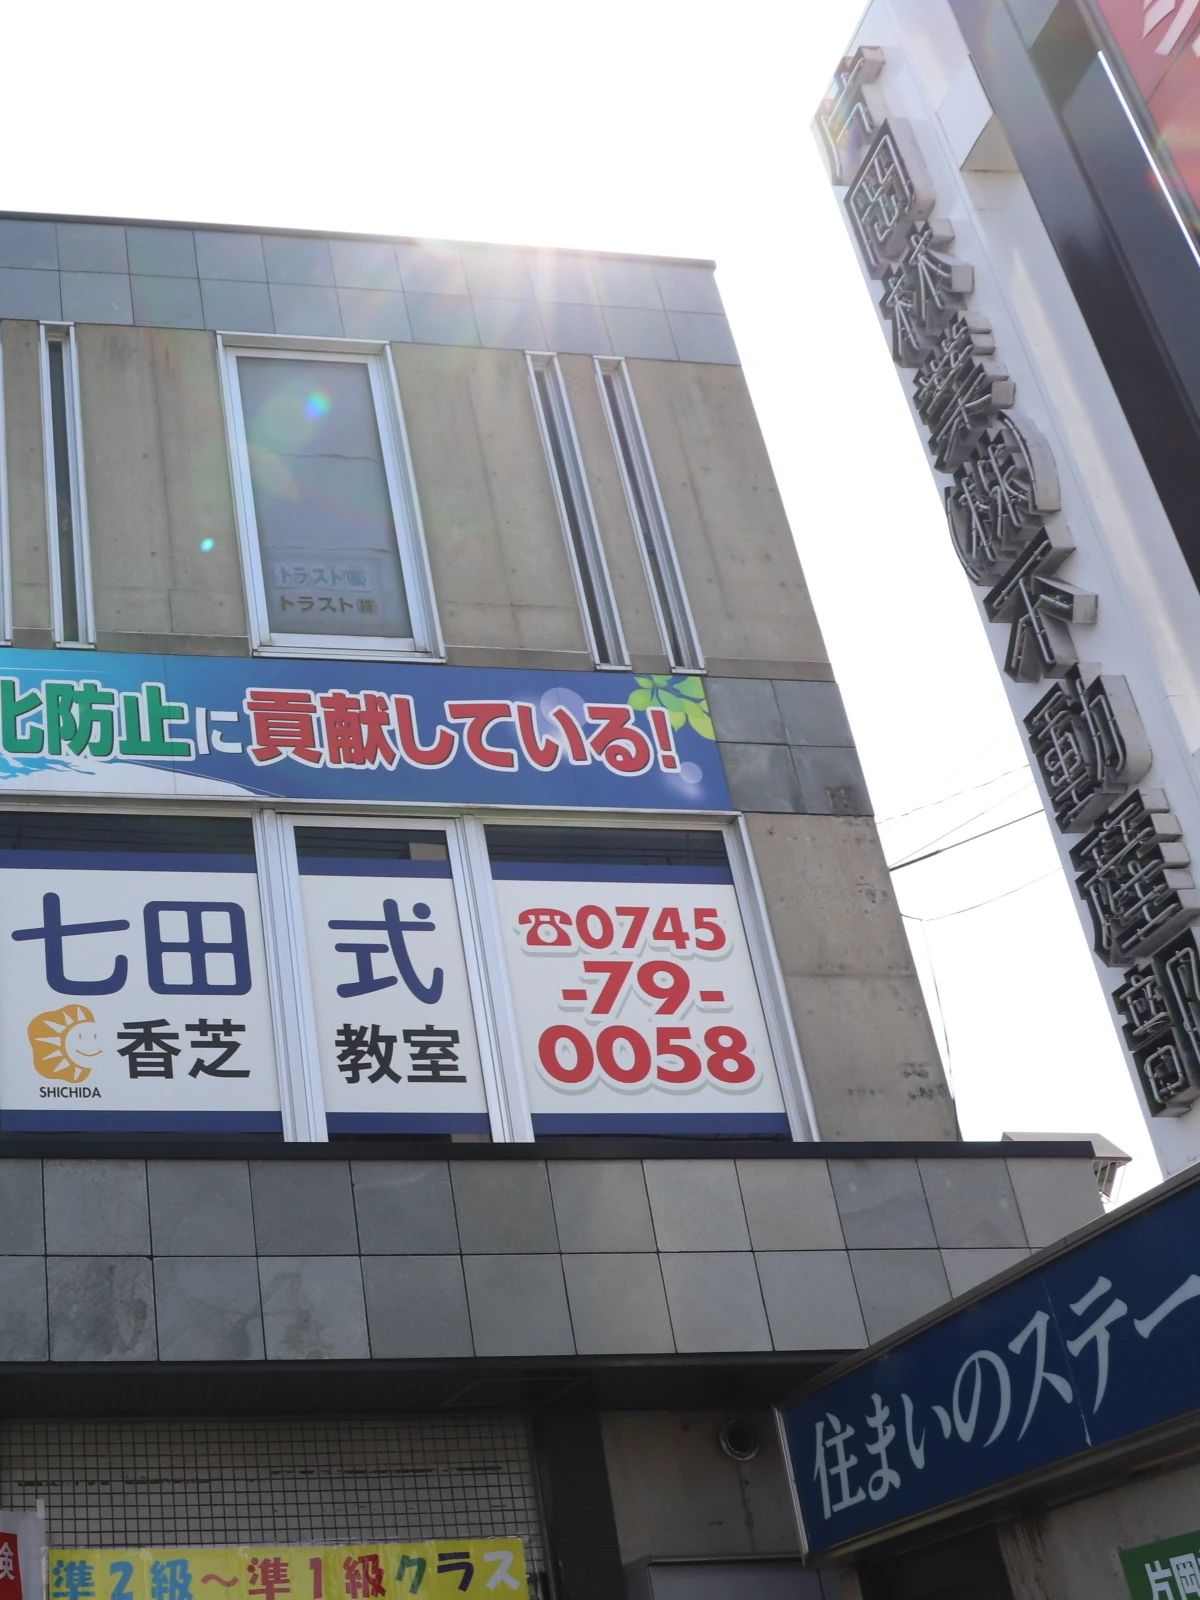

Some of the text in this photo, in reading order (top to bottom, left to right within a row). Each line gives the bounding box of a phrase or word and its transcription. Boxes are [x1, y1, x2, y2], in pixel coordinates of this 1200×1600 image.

[576, 904, 727, 952] 0745
[538, 1024, 756, 1084] 0058
[39, 1086, 102, 1099] SHICHIDA
